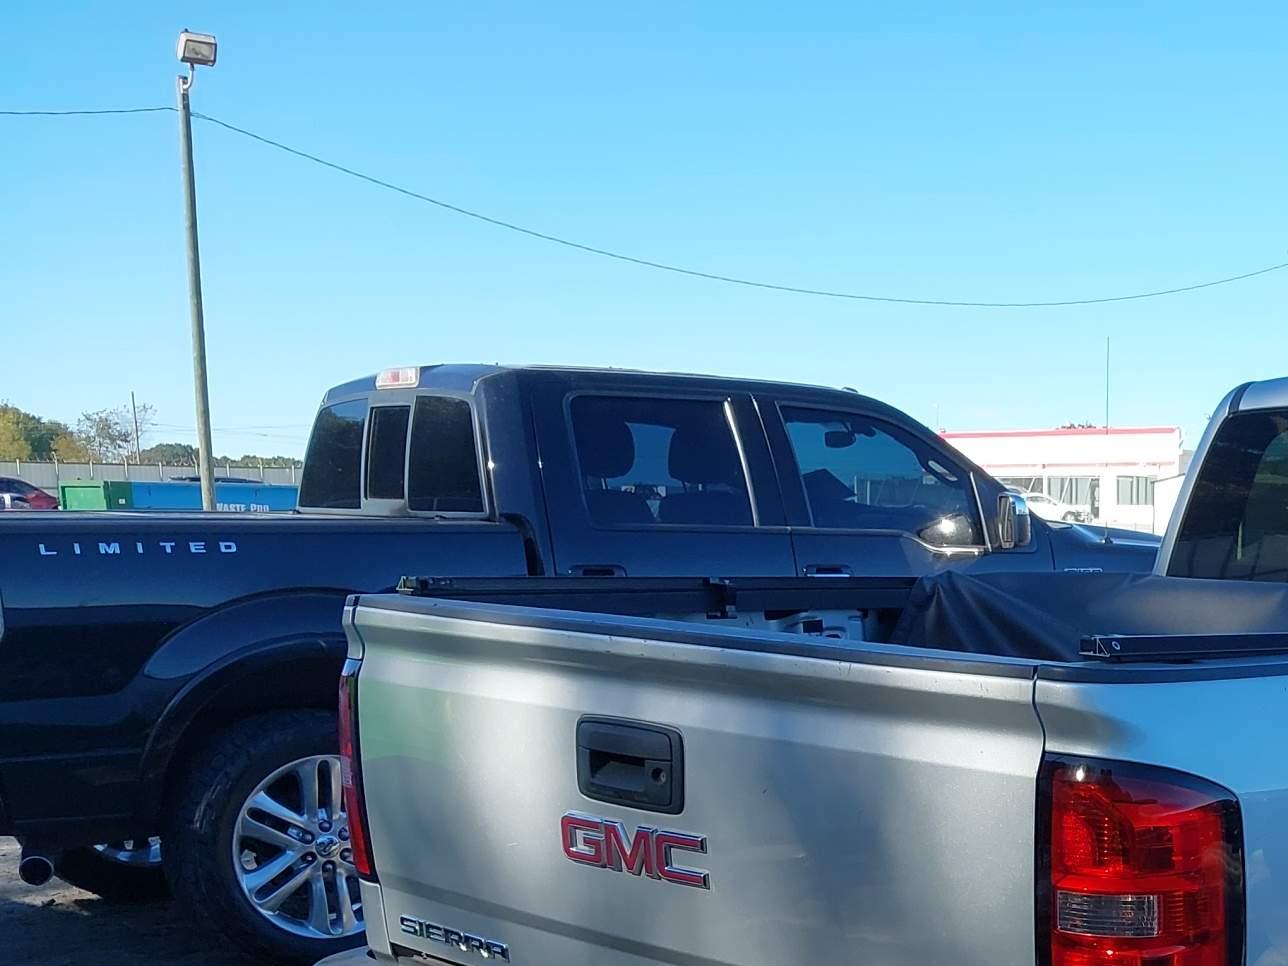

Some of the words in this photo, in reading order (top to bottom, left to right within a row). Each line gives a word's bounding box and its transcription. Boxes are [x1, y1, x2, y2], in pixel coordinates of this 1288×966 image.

[38, 541, 238, 555] LIMITED
[560, 809, 711, 890] GMC
[400, 914, 510, 962] SIERRA
